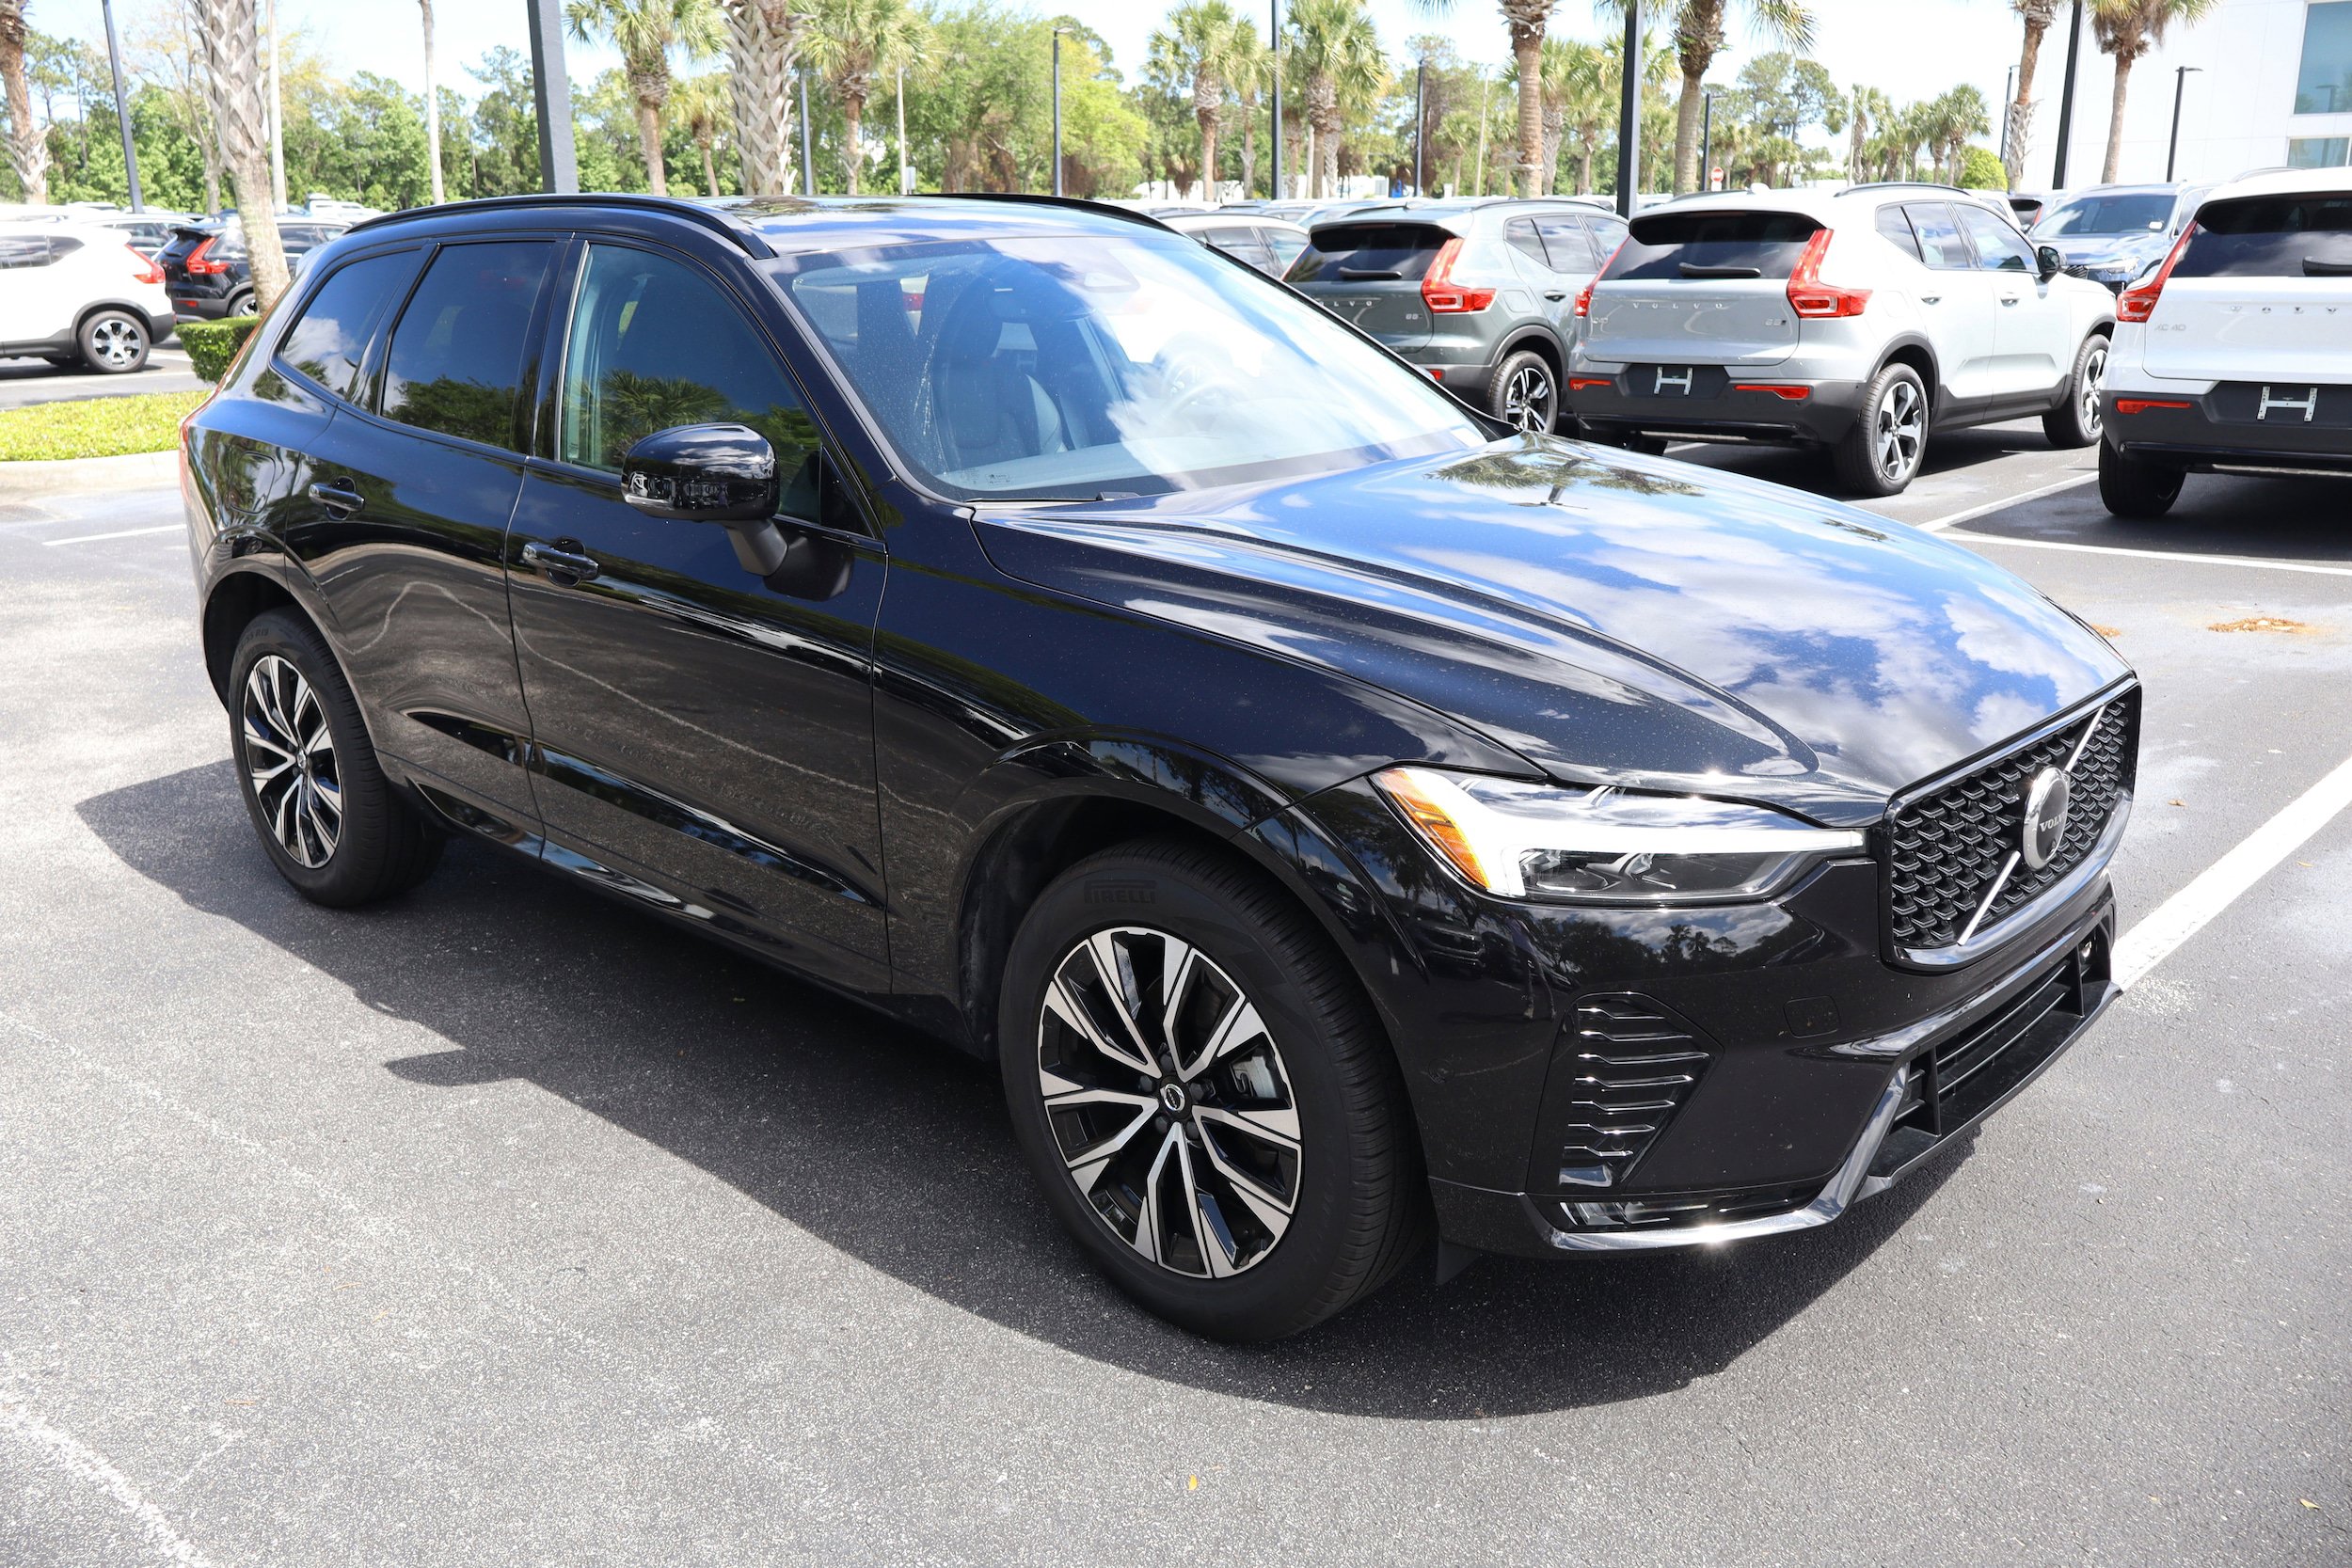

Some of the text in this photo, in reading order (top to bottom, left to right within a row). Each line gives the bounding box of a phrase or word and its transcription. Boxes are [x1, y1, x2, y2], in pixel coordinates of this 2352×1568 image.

[2230, 305, 2340, 314] VOLV
[2039, 811, 2066, 832] VOLV
[1084, 879, 1157, 904] PIRELLI
